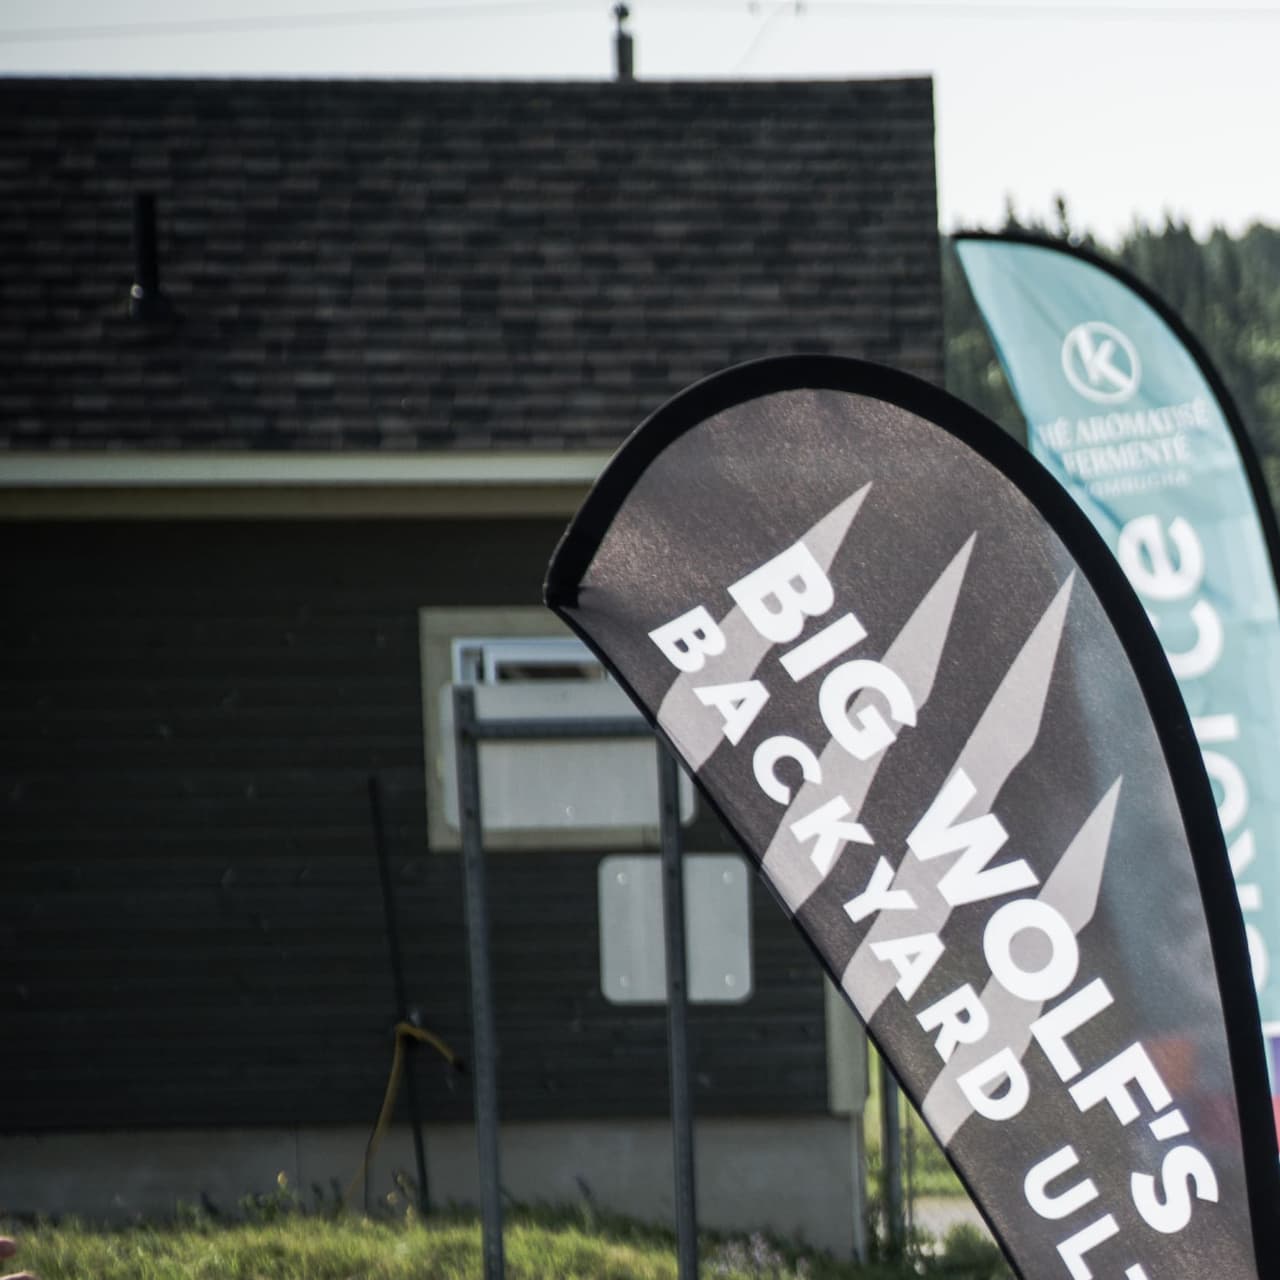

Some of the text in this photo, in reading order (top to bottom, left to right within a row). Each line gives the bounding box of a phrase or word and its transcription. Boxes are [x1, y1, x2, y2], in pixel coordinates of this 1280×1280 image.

[647, 604, 1031, 1121] BACKYARD
[727, 540, 917, 761] BIG
[905, 767, 1219, 1234] WOLF'S
